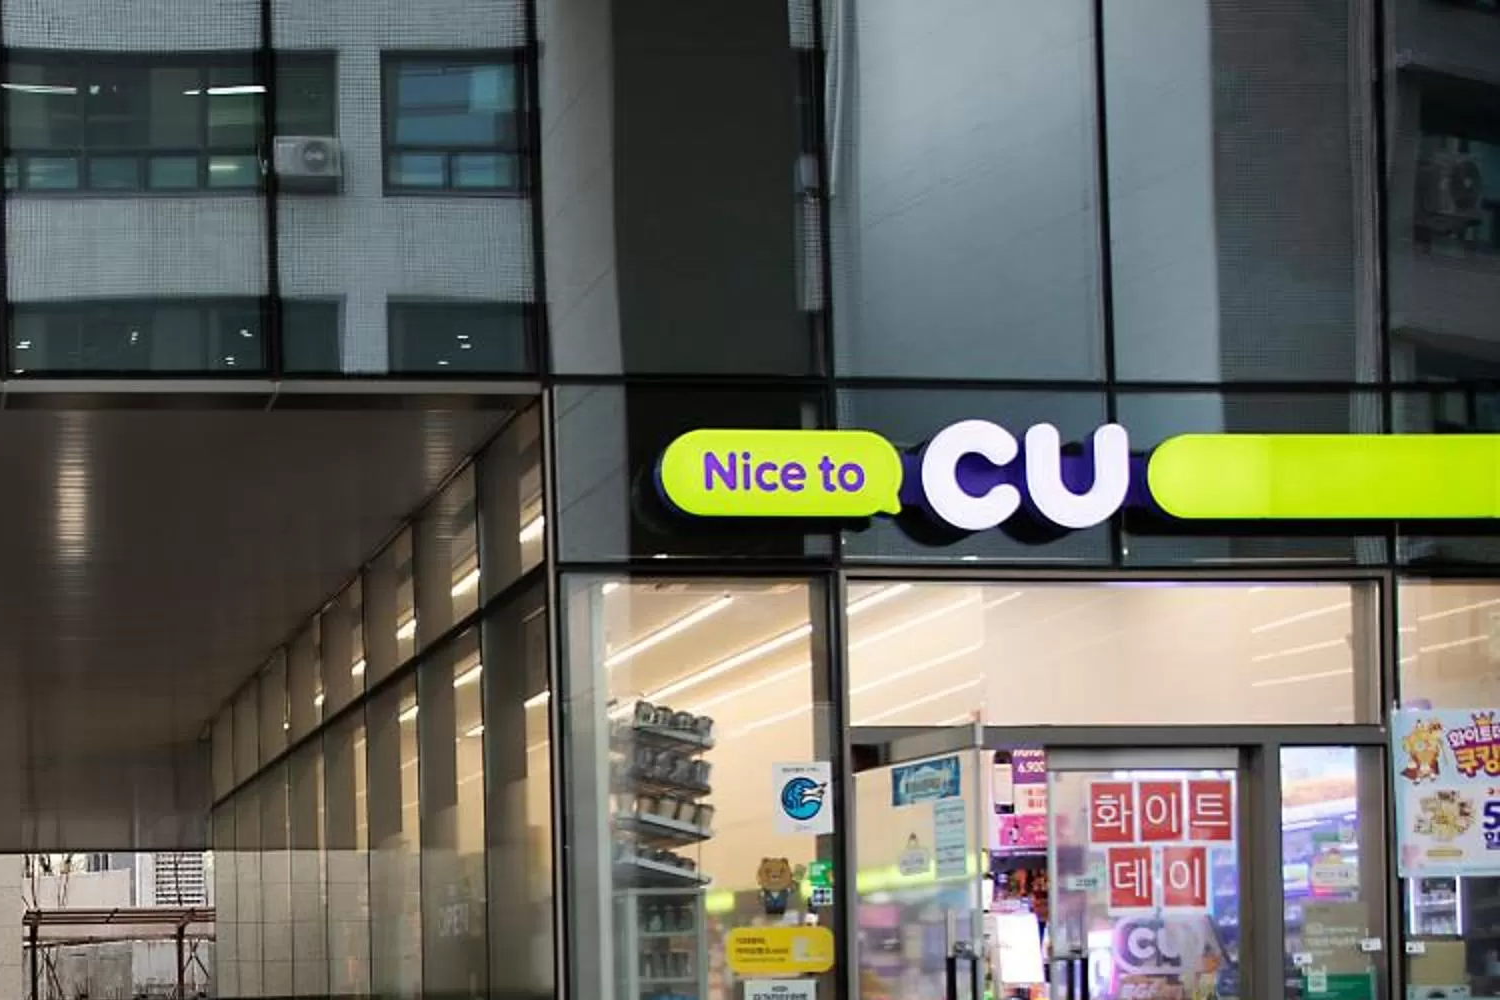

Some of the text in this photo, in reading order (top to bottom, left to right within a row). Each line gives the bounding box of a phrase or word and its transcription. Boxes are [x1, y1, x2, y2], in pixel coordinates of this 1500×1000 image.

[703, 419, 1131, 531] Nice to CU
[1093, 793, 1230, 833] 화이트
[1113, 859, 1202, 899] 데이
